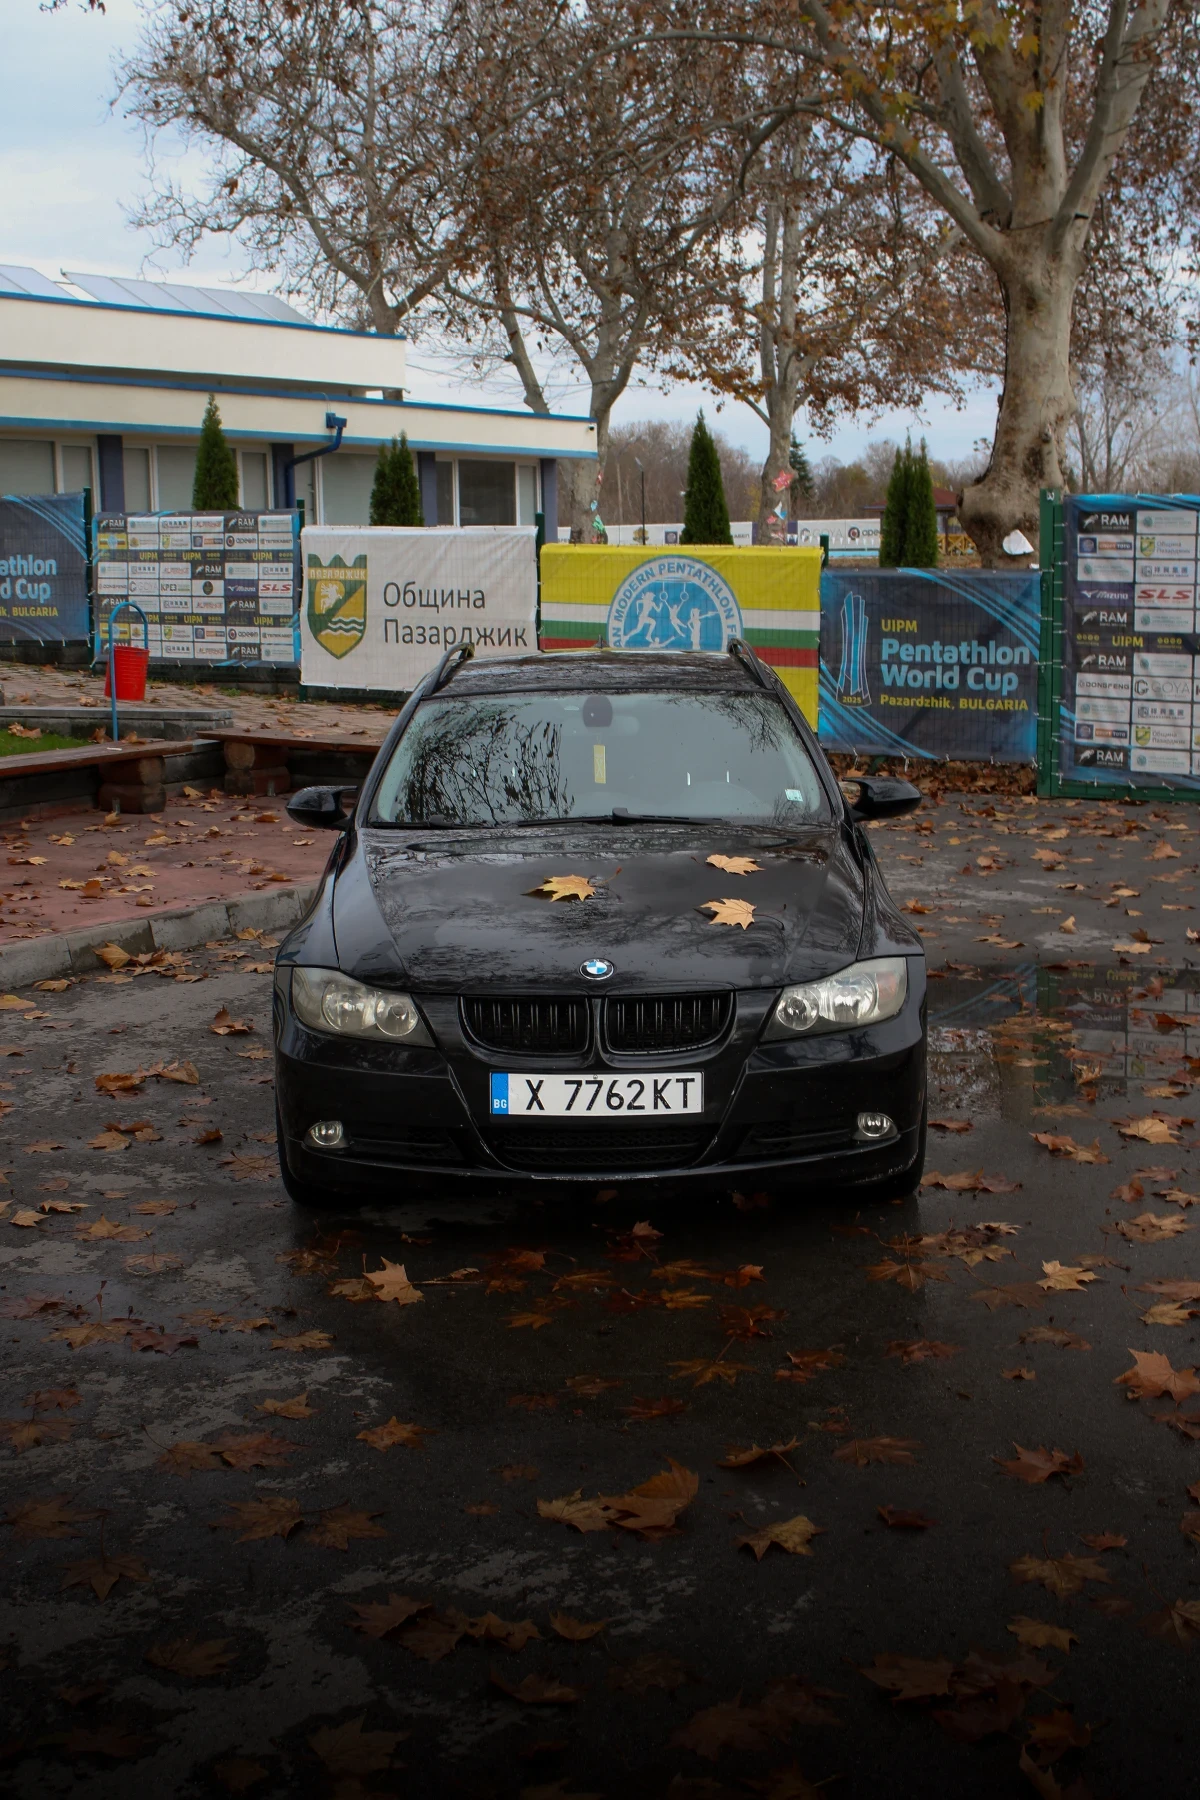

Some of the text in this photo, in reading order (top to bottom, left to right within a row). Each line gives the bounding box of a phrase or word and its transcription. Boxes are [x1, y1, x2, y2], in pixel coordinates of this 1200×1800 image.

[237, 518, 255, 527] RAM
[1101, 514, 1130, 525] RAM
[139, 552, 158, 561] UIPM
[182, 552, 202, 561] UIPM
[252, 552, 273, 561] UIPM
[205, 565, 222, 574] RAM
[15, 578, 51, 604] Cup
[260, 583, 292, 592] SLS
[614, 567, 656, 622] MODERN
[658, 562, 735, 620] PENTATHLON
[383, 581, 486, 614] Община
[1137, 589, 1192, 600] SLS
[239, 600, 256, 609] RAM
[12, 607, 59, 617] BULGARIA
[1099, 612, 1128, 623] RAM
[183, 615, 203, 624] UIPM
[253, 616, 274, 625] UIPM
[881, 619, 919, 633] UIPM
[383, 618, 529, 651] Пазарджик
[1112, 635, 1144, 647] UIPM
[241, 647, 258, 655] RAM
[881, 638, 1030, 665] Pentathlon
[1098, 655, 1127, 667] RAM
[881, 664, 1019, 696] World Cup
[1152, 681, 1190, 694] GOYA
[880, 694, 1029, 711] Pazardzhik, BULGARIA
[1096, 750, 1124, 763] RAM
[525, 1079, 545, 1110] X
[493, 1099, 507, 1108] BG
